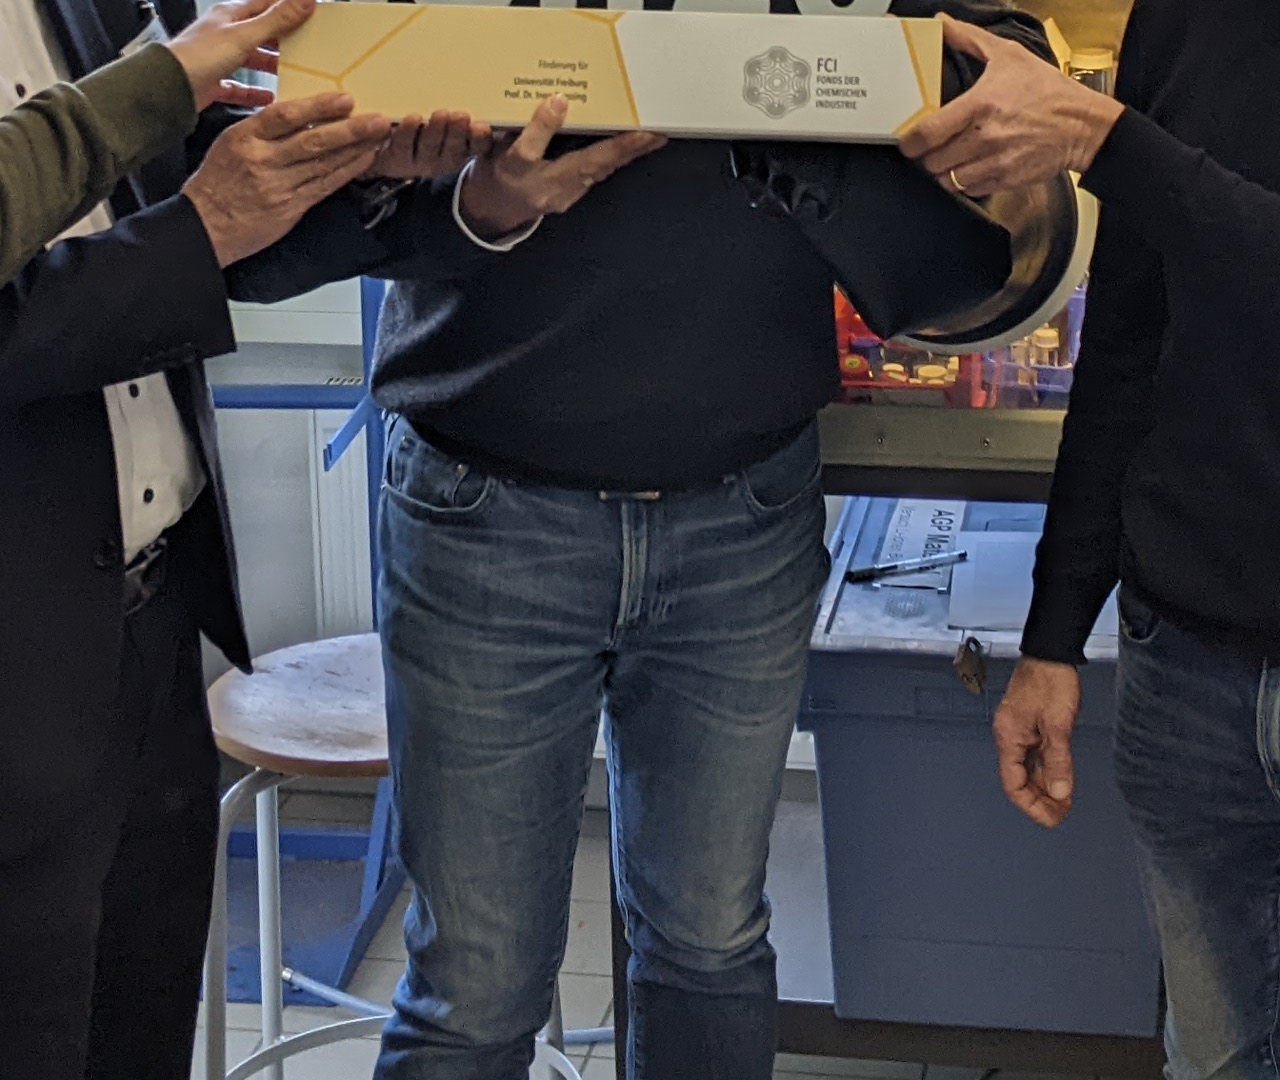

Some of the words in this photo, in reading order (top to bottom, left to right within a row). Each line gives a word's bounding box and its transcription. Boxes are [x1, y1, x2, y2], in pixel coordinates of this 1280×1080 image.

[817, 58, 838, 72] FCI
[556, 77, 588, 89] Freiburg
[816, 76, 843, 85] FONDS
[844, 77, 860, 85] DER
[816, 88, 867, 98] CHEMISCHEN
[815, 100, 857, 110] INDUSTRIE
[929, 508, 955, 532] AGP
